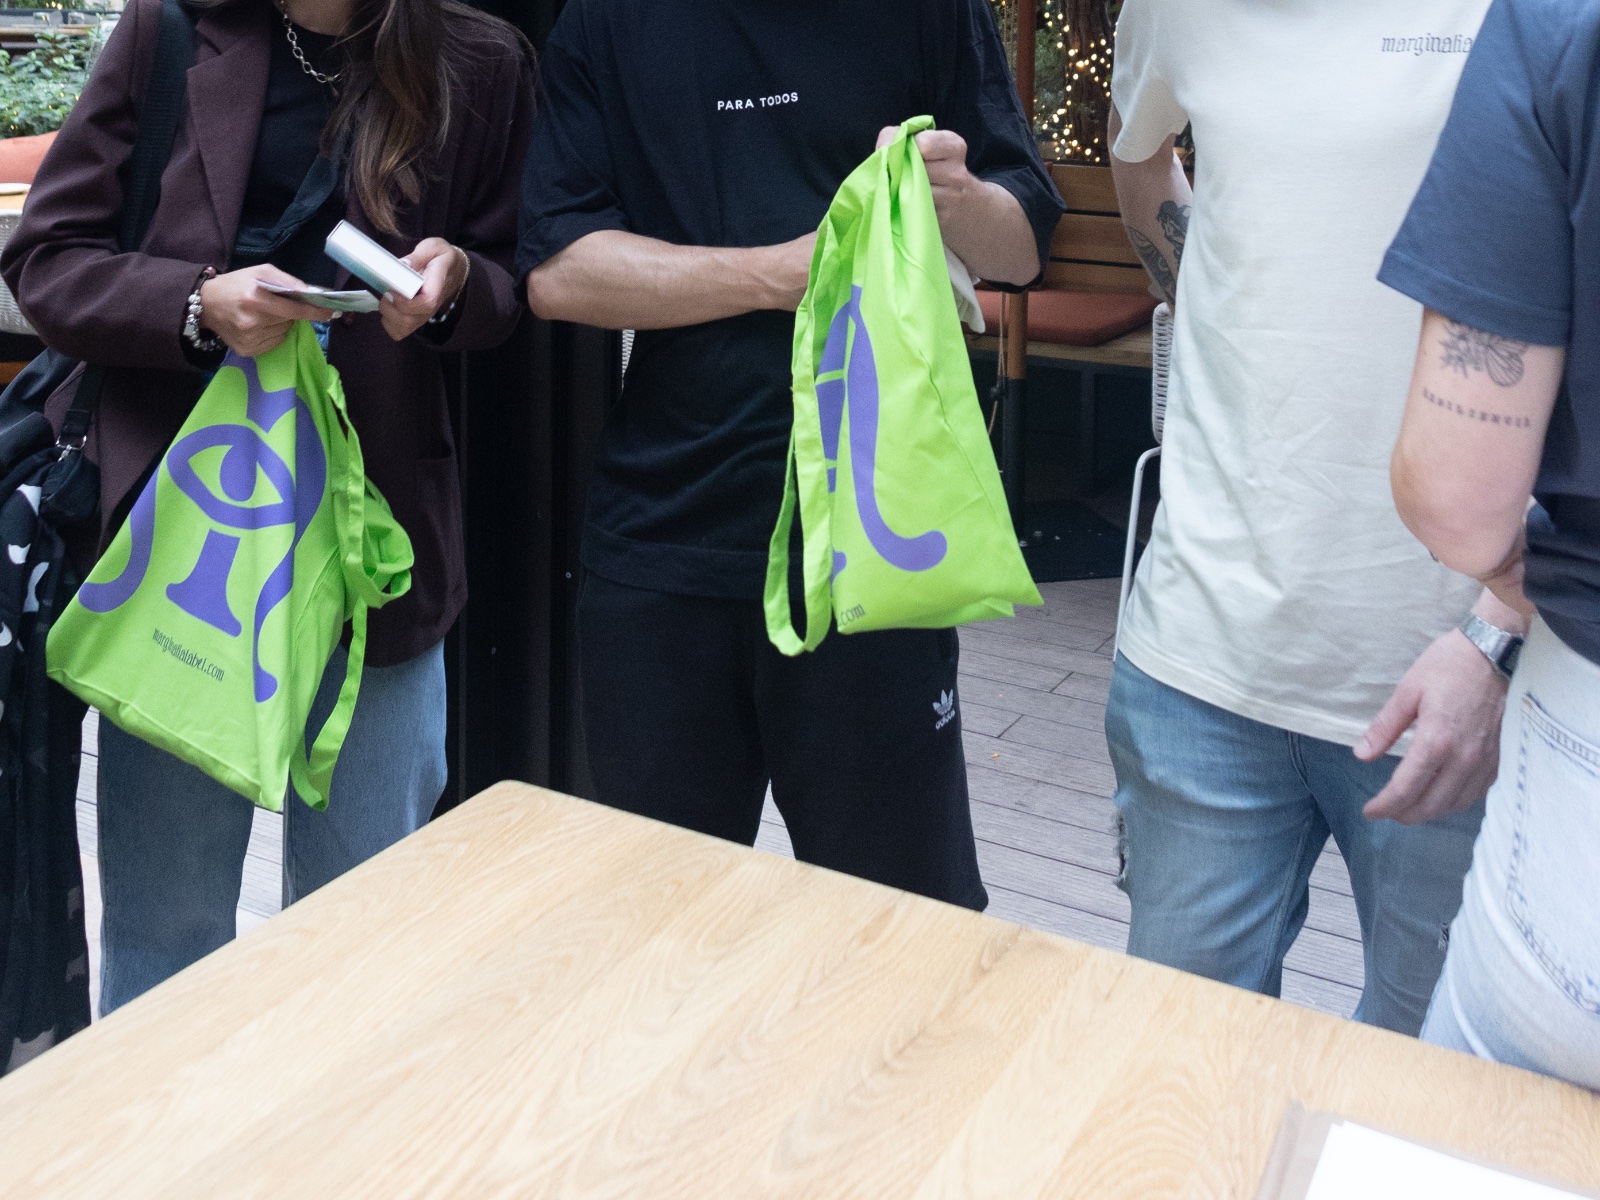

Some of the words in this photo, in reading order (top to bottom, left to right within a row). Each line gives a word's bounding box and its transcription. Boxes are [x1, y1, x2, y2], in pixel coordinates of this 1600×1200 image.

[1381, 32, 1473, 56] marginalia
[717, 99, 754, 111] PARA
[760, 92, 799, 108] TODOS
